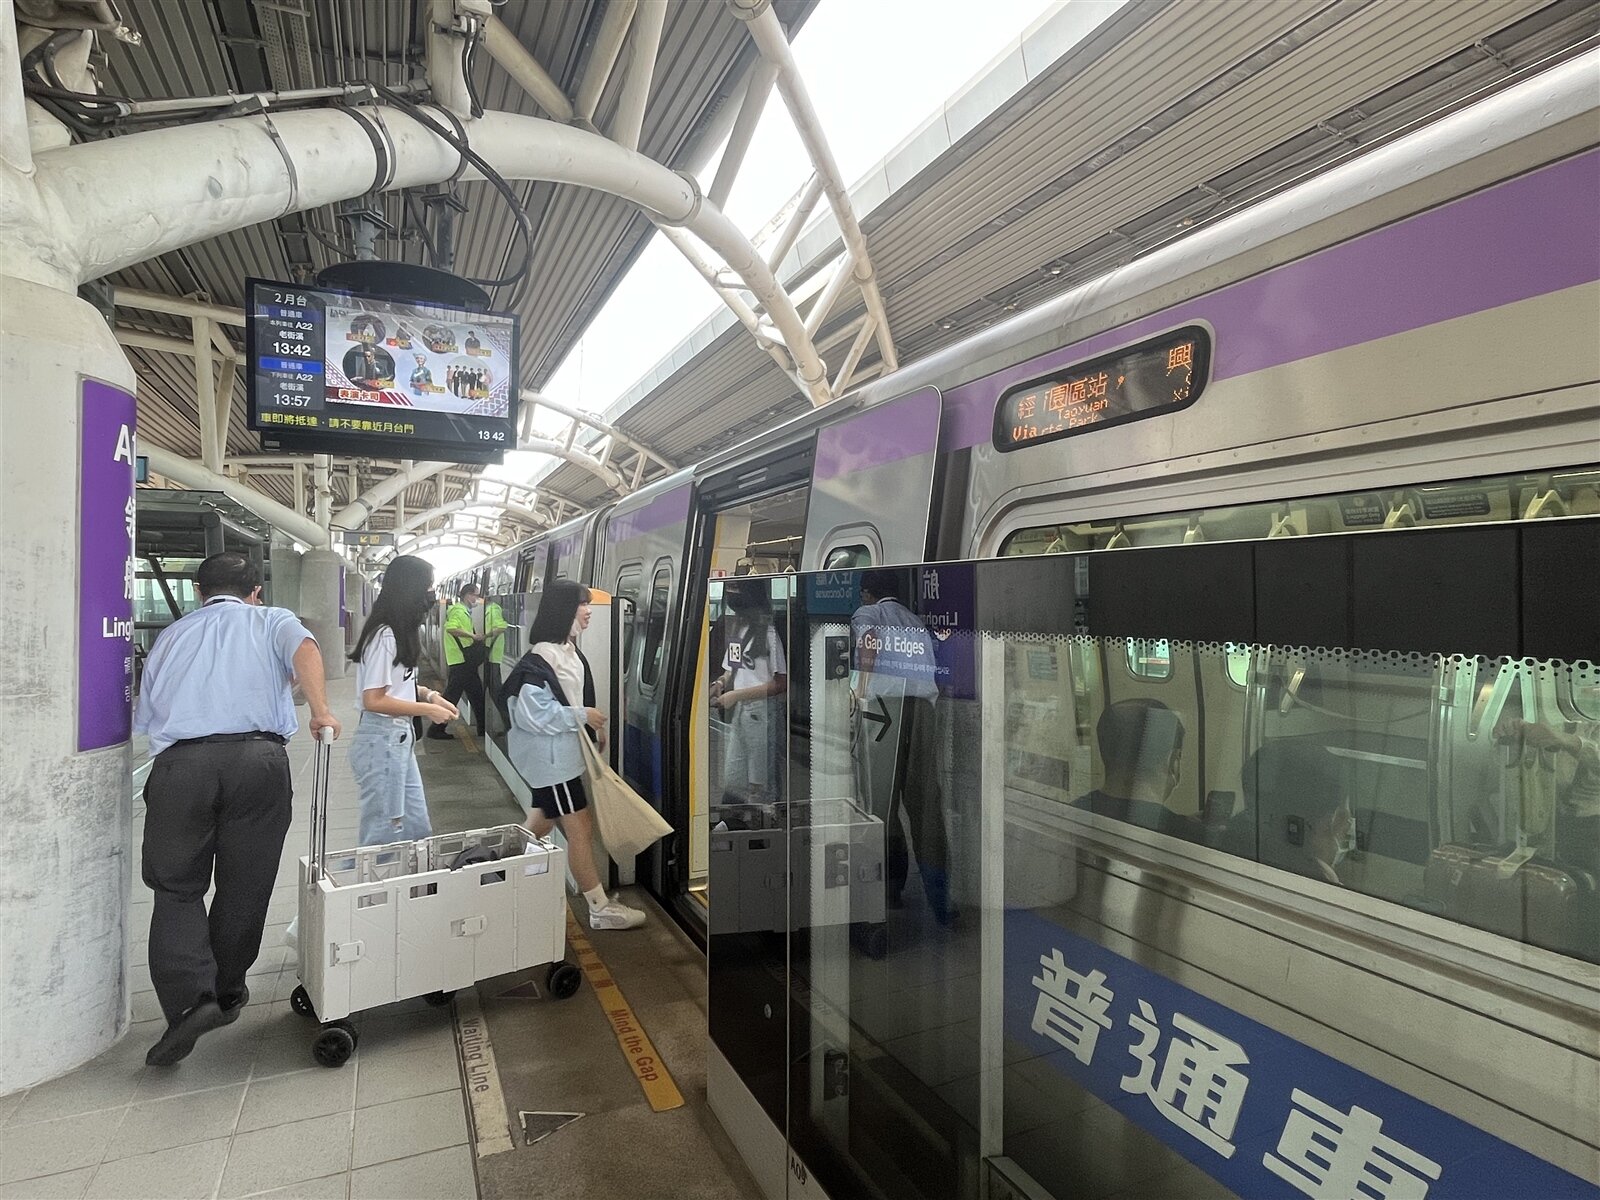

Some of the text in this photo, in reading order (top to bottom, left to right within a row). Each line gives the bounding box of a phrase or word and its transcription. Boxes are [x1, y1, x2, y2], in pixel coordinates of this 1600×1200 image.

[295, 321, 314, 331] A22
[273, 341, 312, 357] 13:42
[295, 373, 314, 382] A22
[273, 393, 312, 407] 13:57
[1057, 398, 1109, 420] Taoyuan
[1012, 424, 1039, 441] Via
[730, 645, 740, 660] 1-3
[864, 633, 882, 654] Gap
[884, 636, 893, 652] &
[894, 636, 925, 658] Edges
[610, 1008, 659, 1082] Mind the Gap
[462, 1017, 491, 1093] Waiting Line
[1031, 947, 1443, 1200] 普通車
